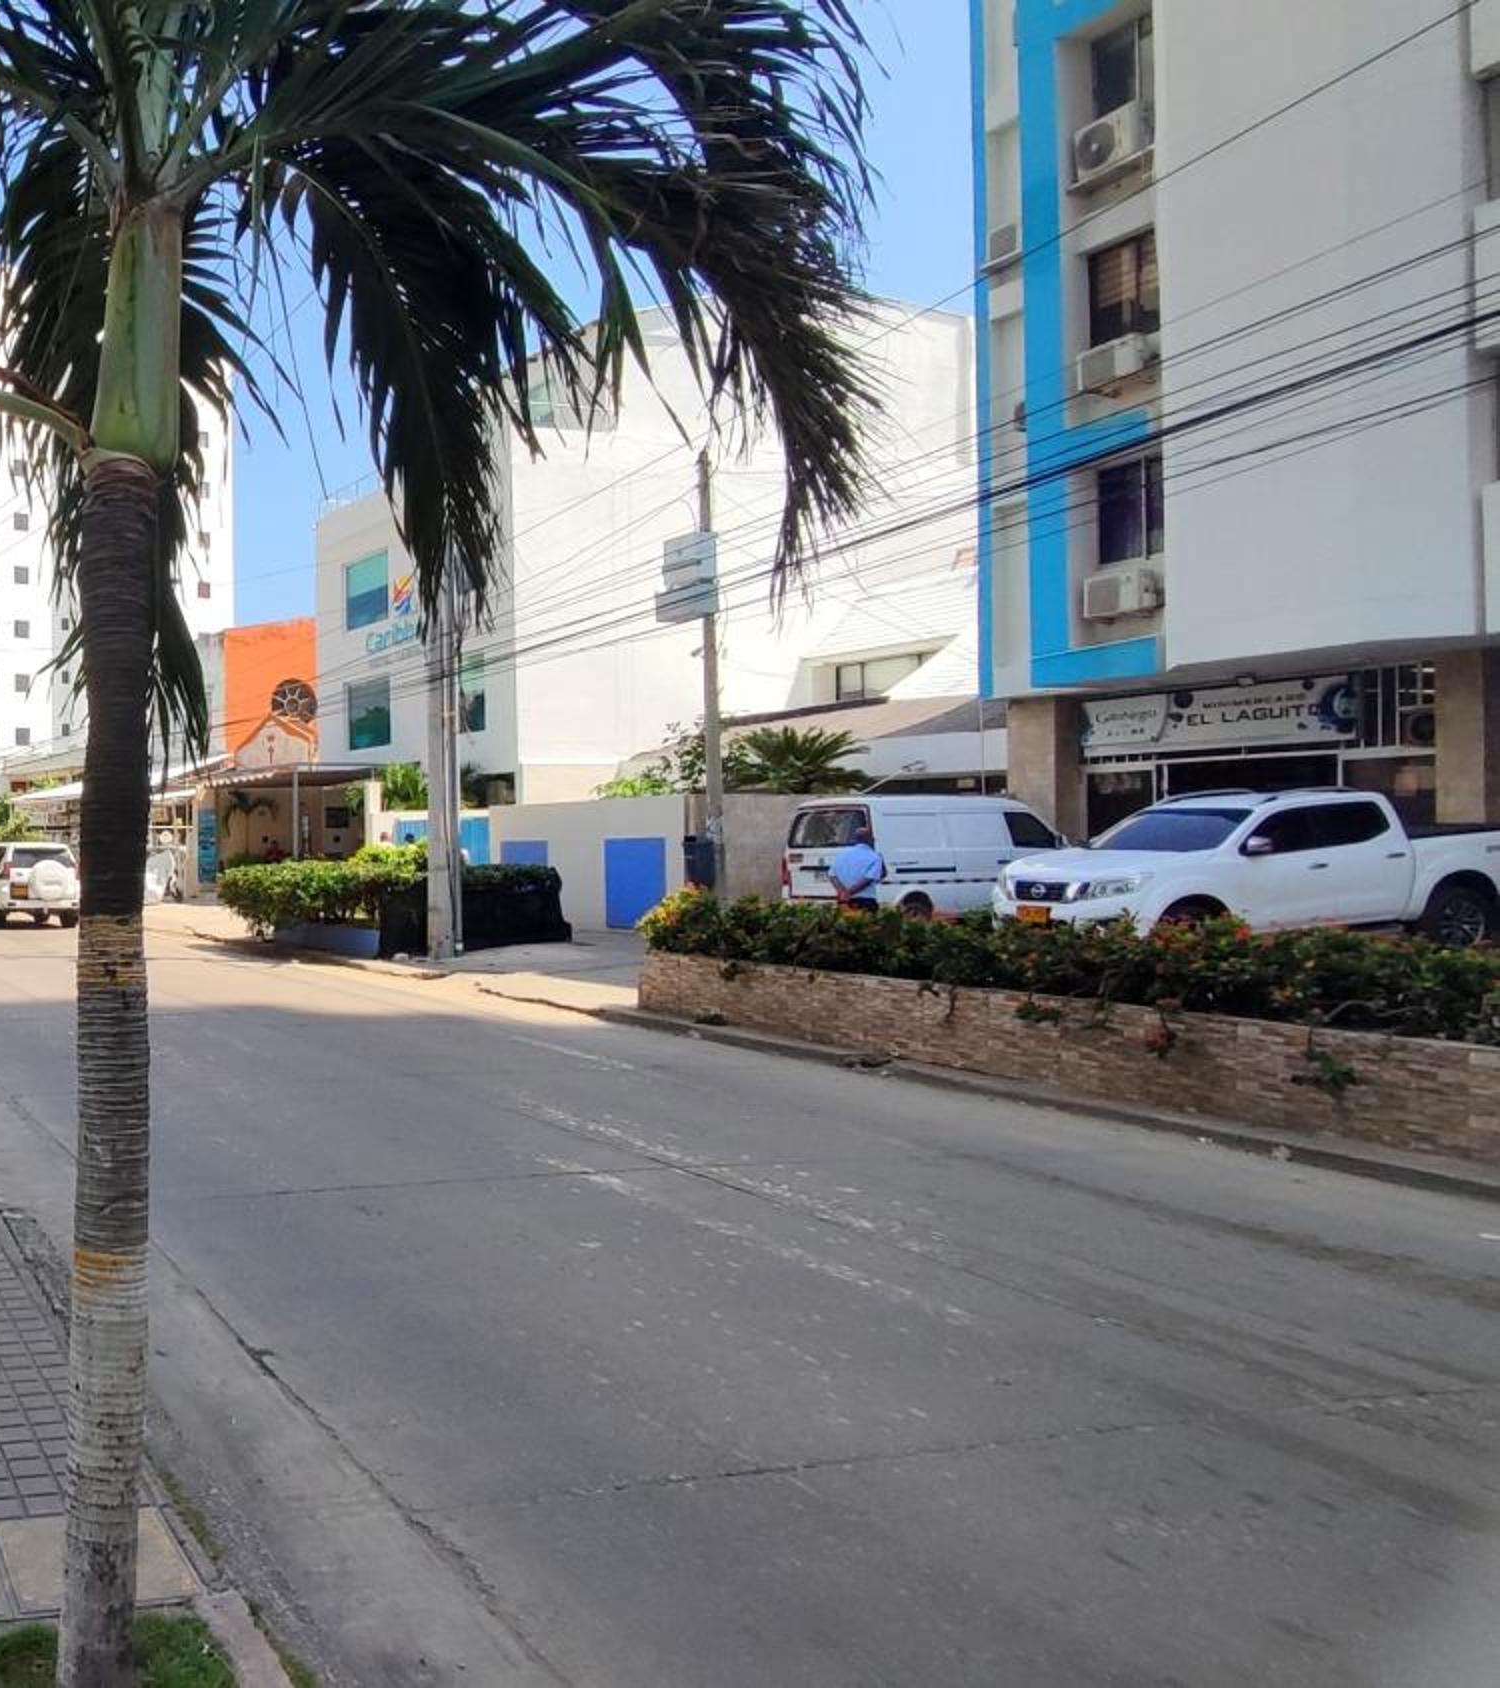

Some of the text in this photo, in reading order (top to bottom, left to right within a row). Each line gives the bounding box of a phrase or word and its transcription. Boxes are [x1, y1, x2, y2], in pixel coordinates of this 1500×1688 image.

[1202, 692, 1306, 709] MINIMERCADO
[1187, 703, 1320, 727] EL LAGUITO
